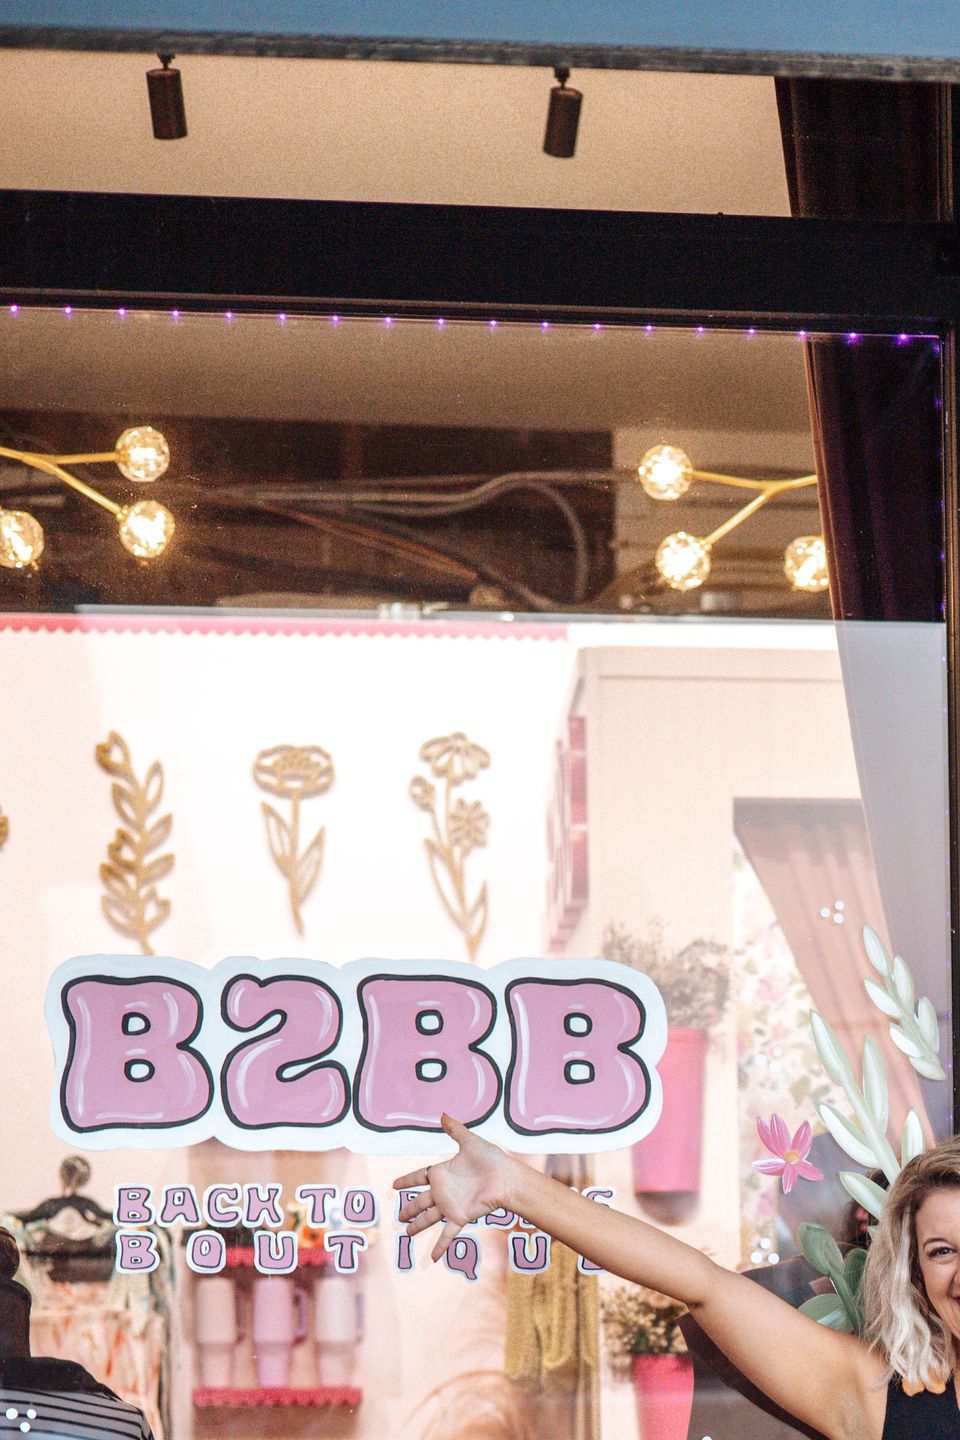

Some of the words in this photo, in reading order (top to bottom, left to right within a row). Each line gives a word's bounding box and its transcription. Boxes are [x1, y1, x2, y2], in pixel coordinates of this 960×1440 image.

[59, 972, 654, 1136] B2BB
[114, 1184, 285, 1228] BACK
[299, 1185, 379, 1229] TO
[115, 1231, 606, 1281] BOUTIQU
